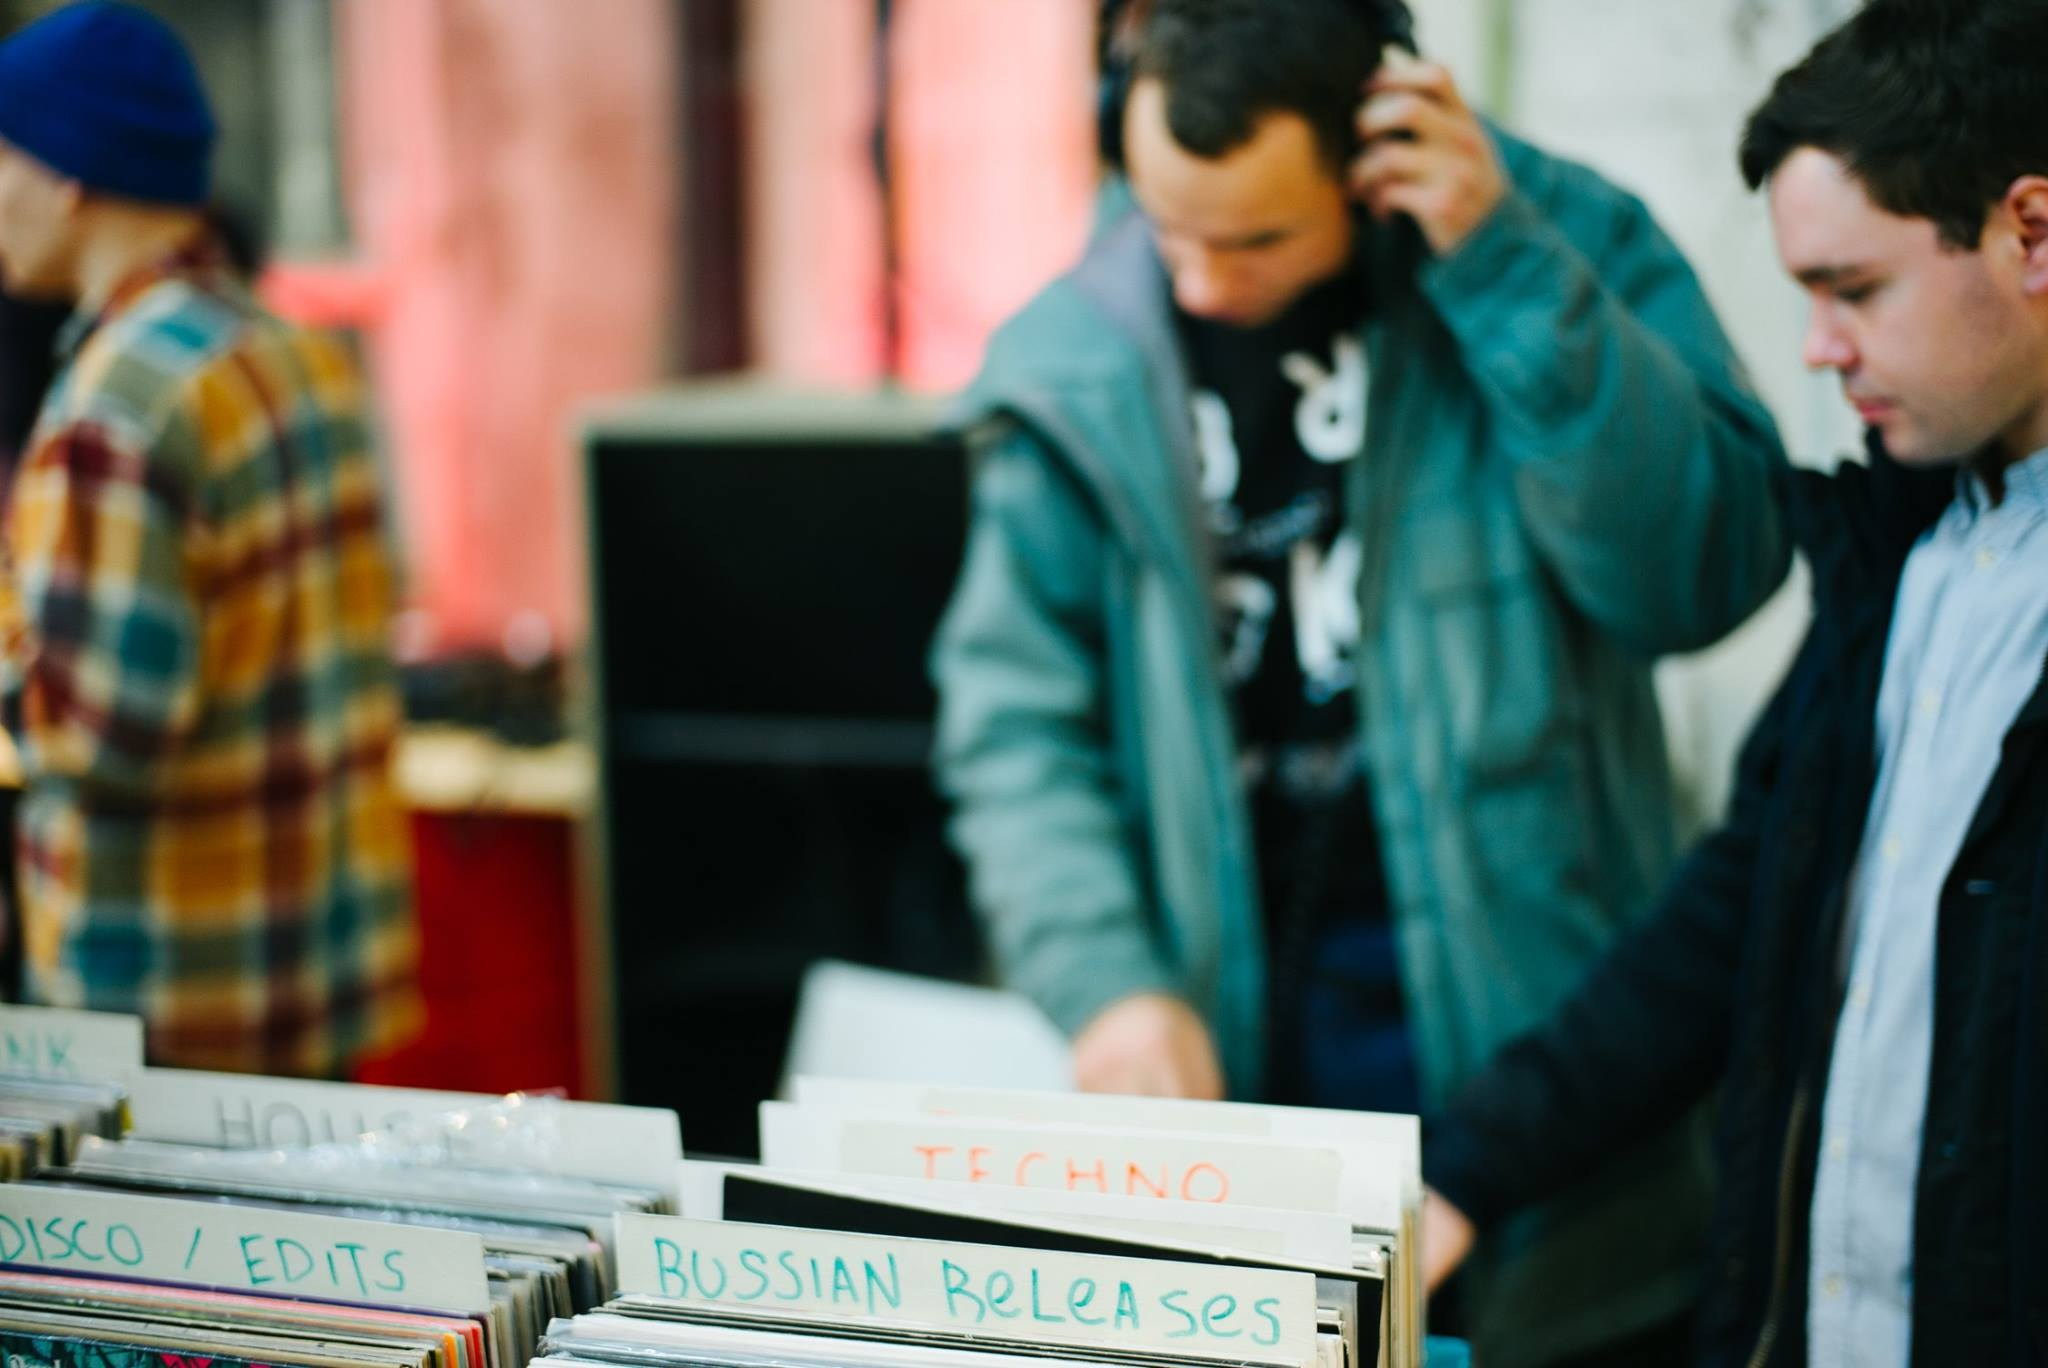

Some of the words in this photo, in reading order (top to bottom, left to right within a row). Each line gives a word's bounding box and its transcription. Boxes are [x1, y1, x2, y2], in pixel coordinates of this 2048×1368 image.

[0, 1213, 145, 1266] DISCO
[239, 1234, 407, 1296] EDITS
[653, 1236, 901, 1316] RUSSIAN
